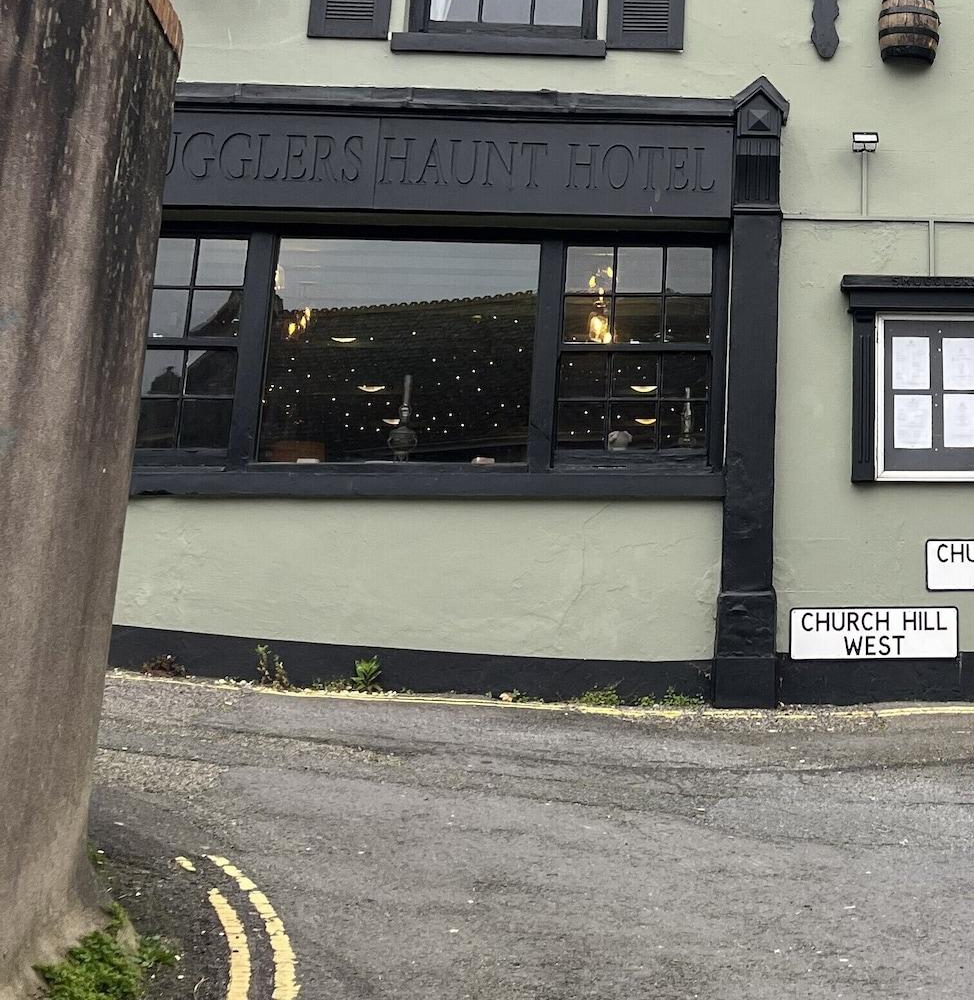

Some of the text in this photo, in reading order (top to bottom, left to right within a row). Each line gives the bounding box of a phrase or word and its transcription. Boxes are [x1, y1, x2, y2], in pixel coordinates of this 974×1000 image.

[377, 134, 548, 188] HAUNT
[566, 141, 717, 193] HOTEL
[801, 611, 948, 632] CHURCH HILL
[844, 635, 905, 656] WEST
